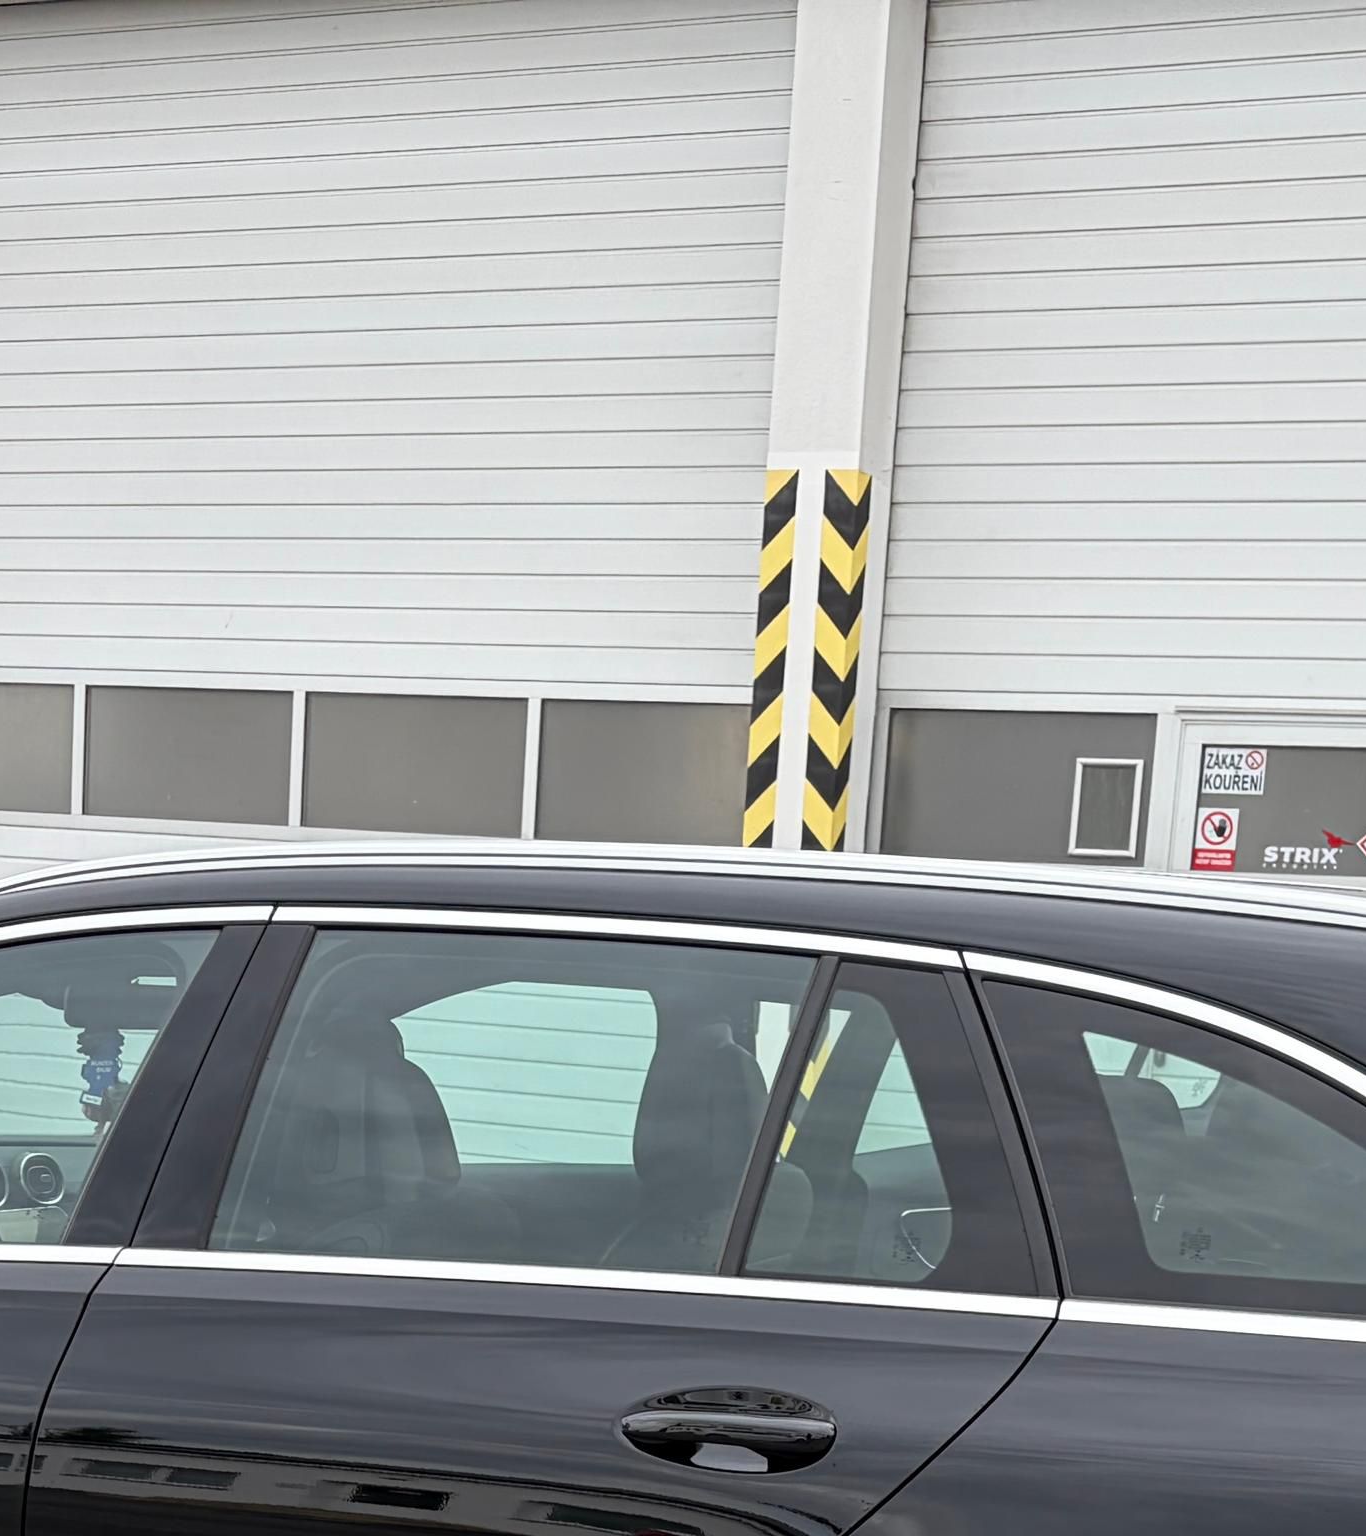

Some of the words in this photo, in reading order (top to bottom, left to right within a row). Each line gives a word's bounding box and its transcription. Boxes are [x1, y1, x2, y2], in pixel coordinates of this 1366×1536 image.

[1206, 751, 1243, 769] ZÁKAZ
[1204, 771, 1263, 791] KOUŘENÍ
[1264, 846, 1338, 864] STRIX
